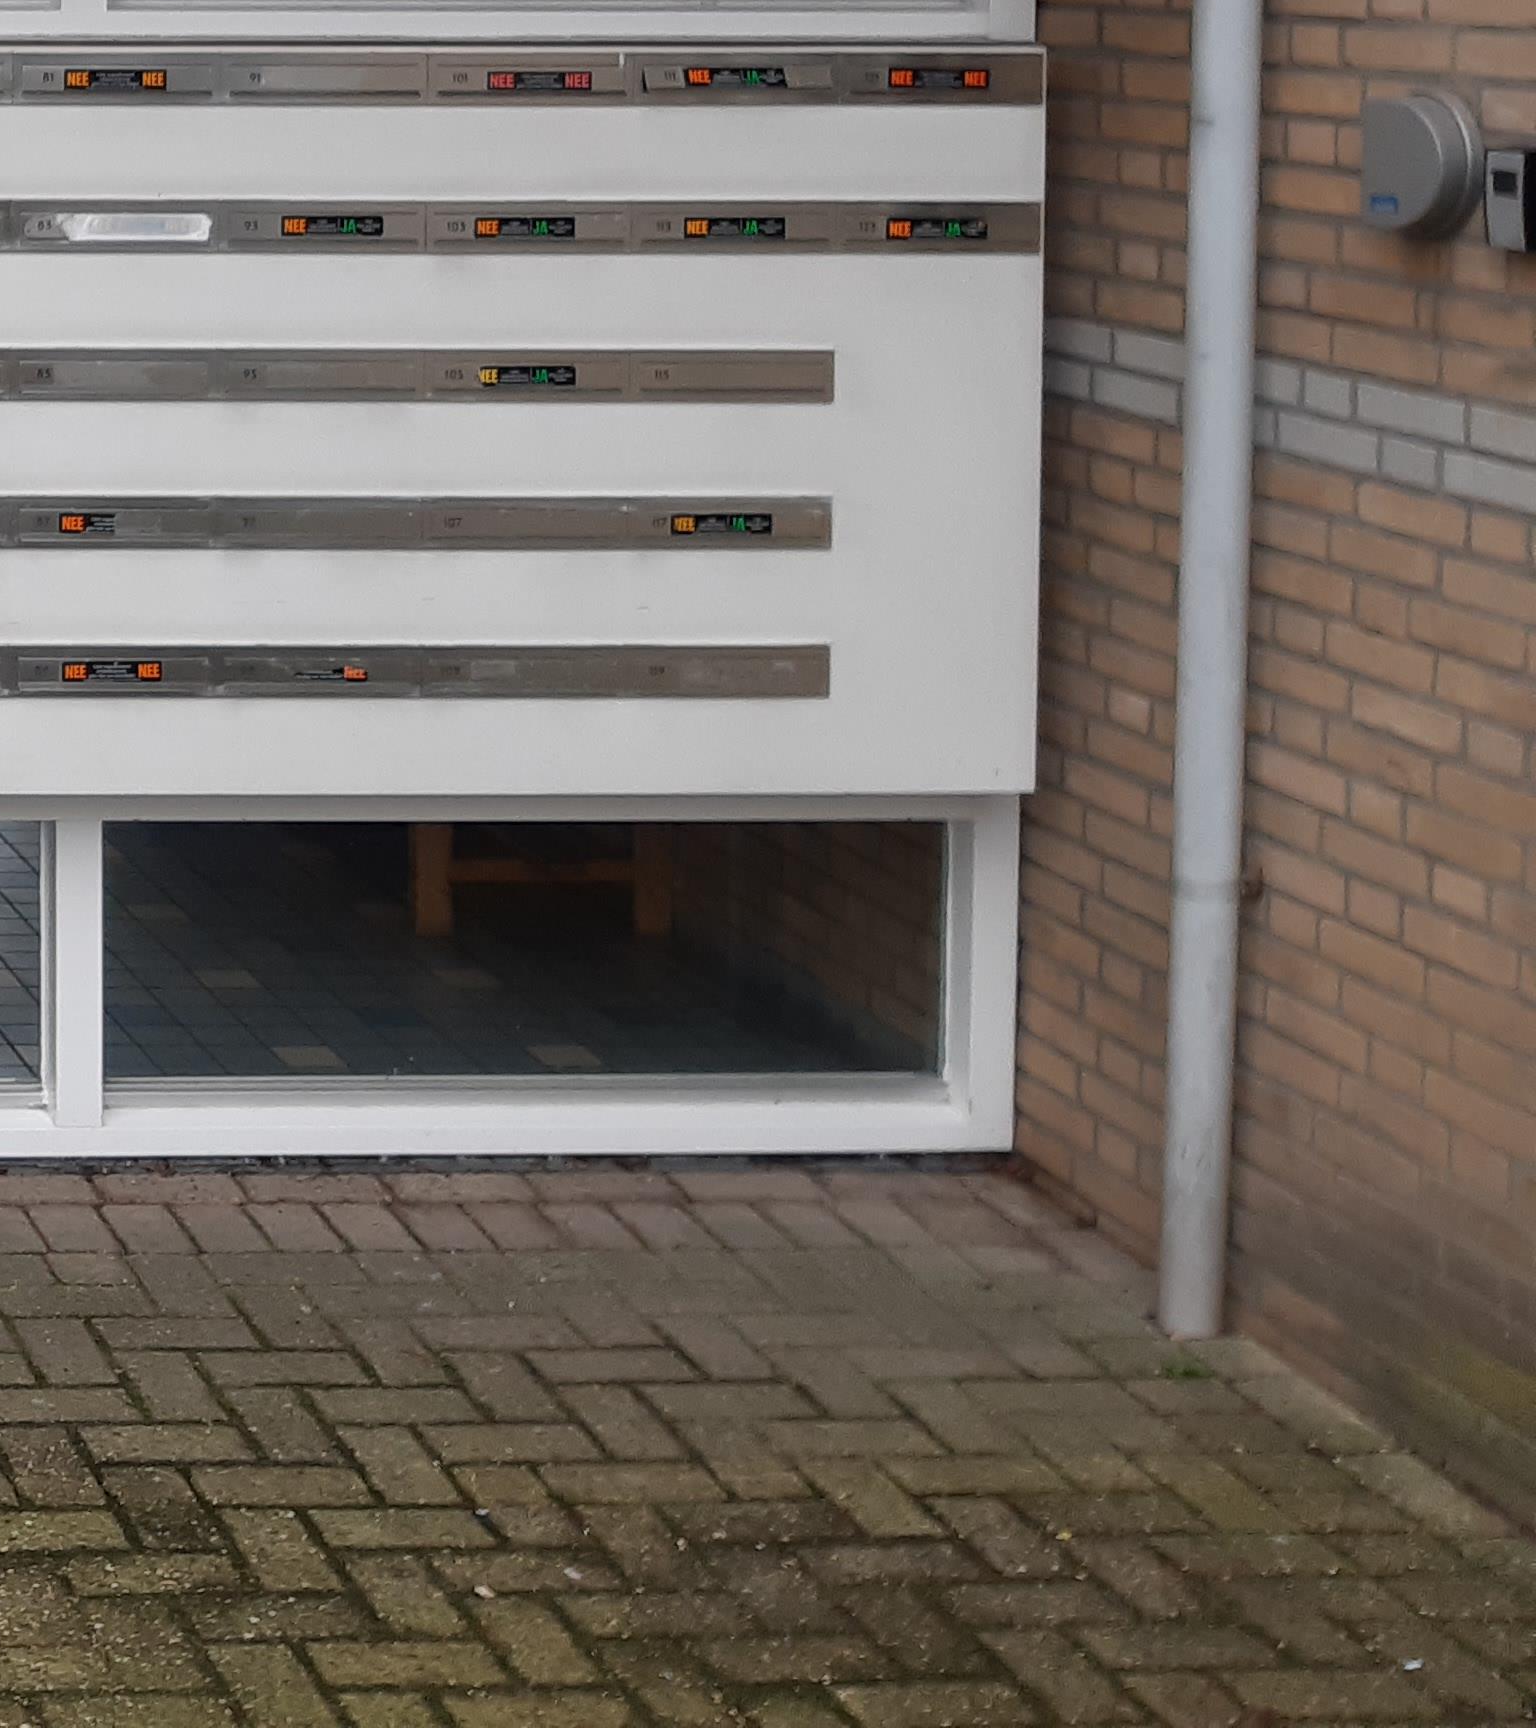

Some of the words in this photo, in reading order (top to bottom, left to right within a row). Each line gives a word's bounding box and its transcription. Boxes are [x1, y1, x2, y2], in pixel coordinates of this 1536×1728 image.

[67, 72, 89, 87] NEE
[143, 72, 164, 87] NEE
[490, 73, 514, 88] NEE
[565, 73, 590, 88] NEE
[284, 218, 306, 233] NEE
[340, 219, 357, 233] JA
[477, 220, 499, 234] NEE
[535, 220, 548, 234] JA
[745, 220, 758, 234] JA
[534, 368, 549, 383] JA
[62, 516, 85, 531] NEE
[64, 664, 87, 679] NEE
[138, 663, 160, 678] NEE
